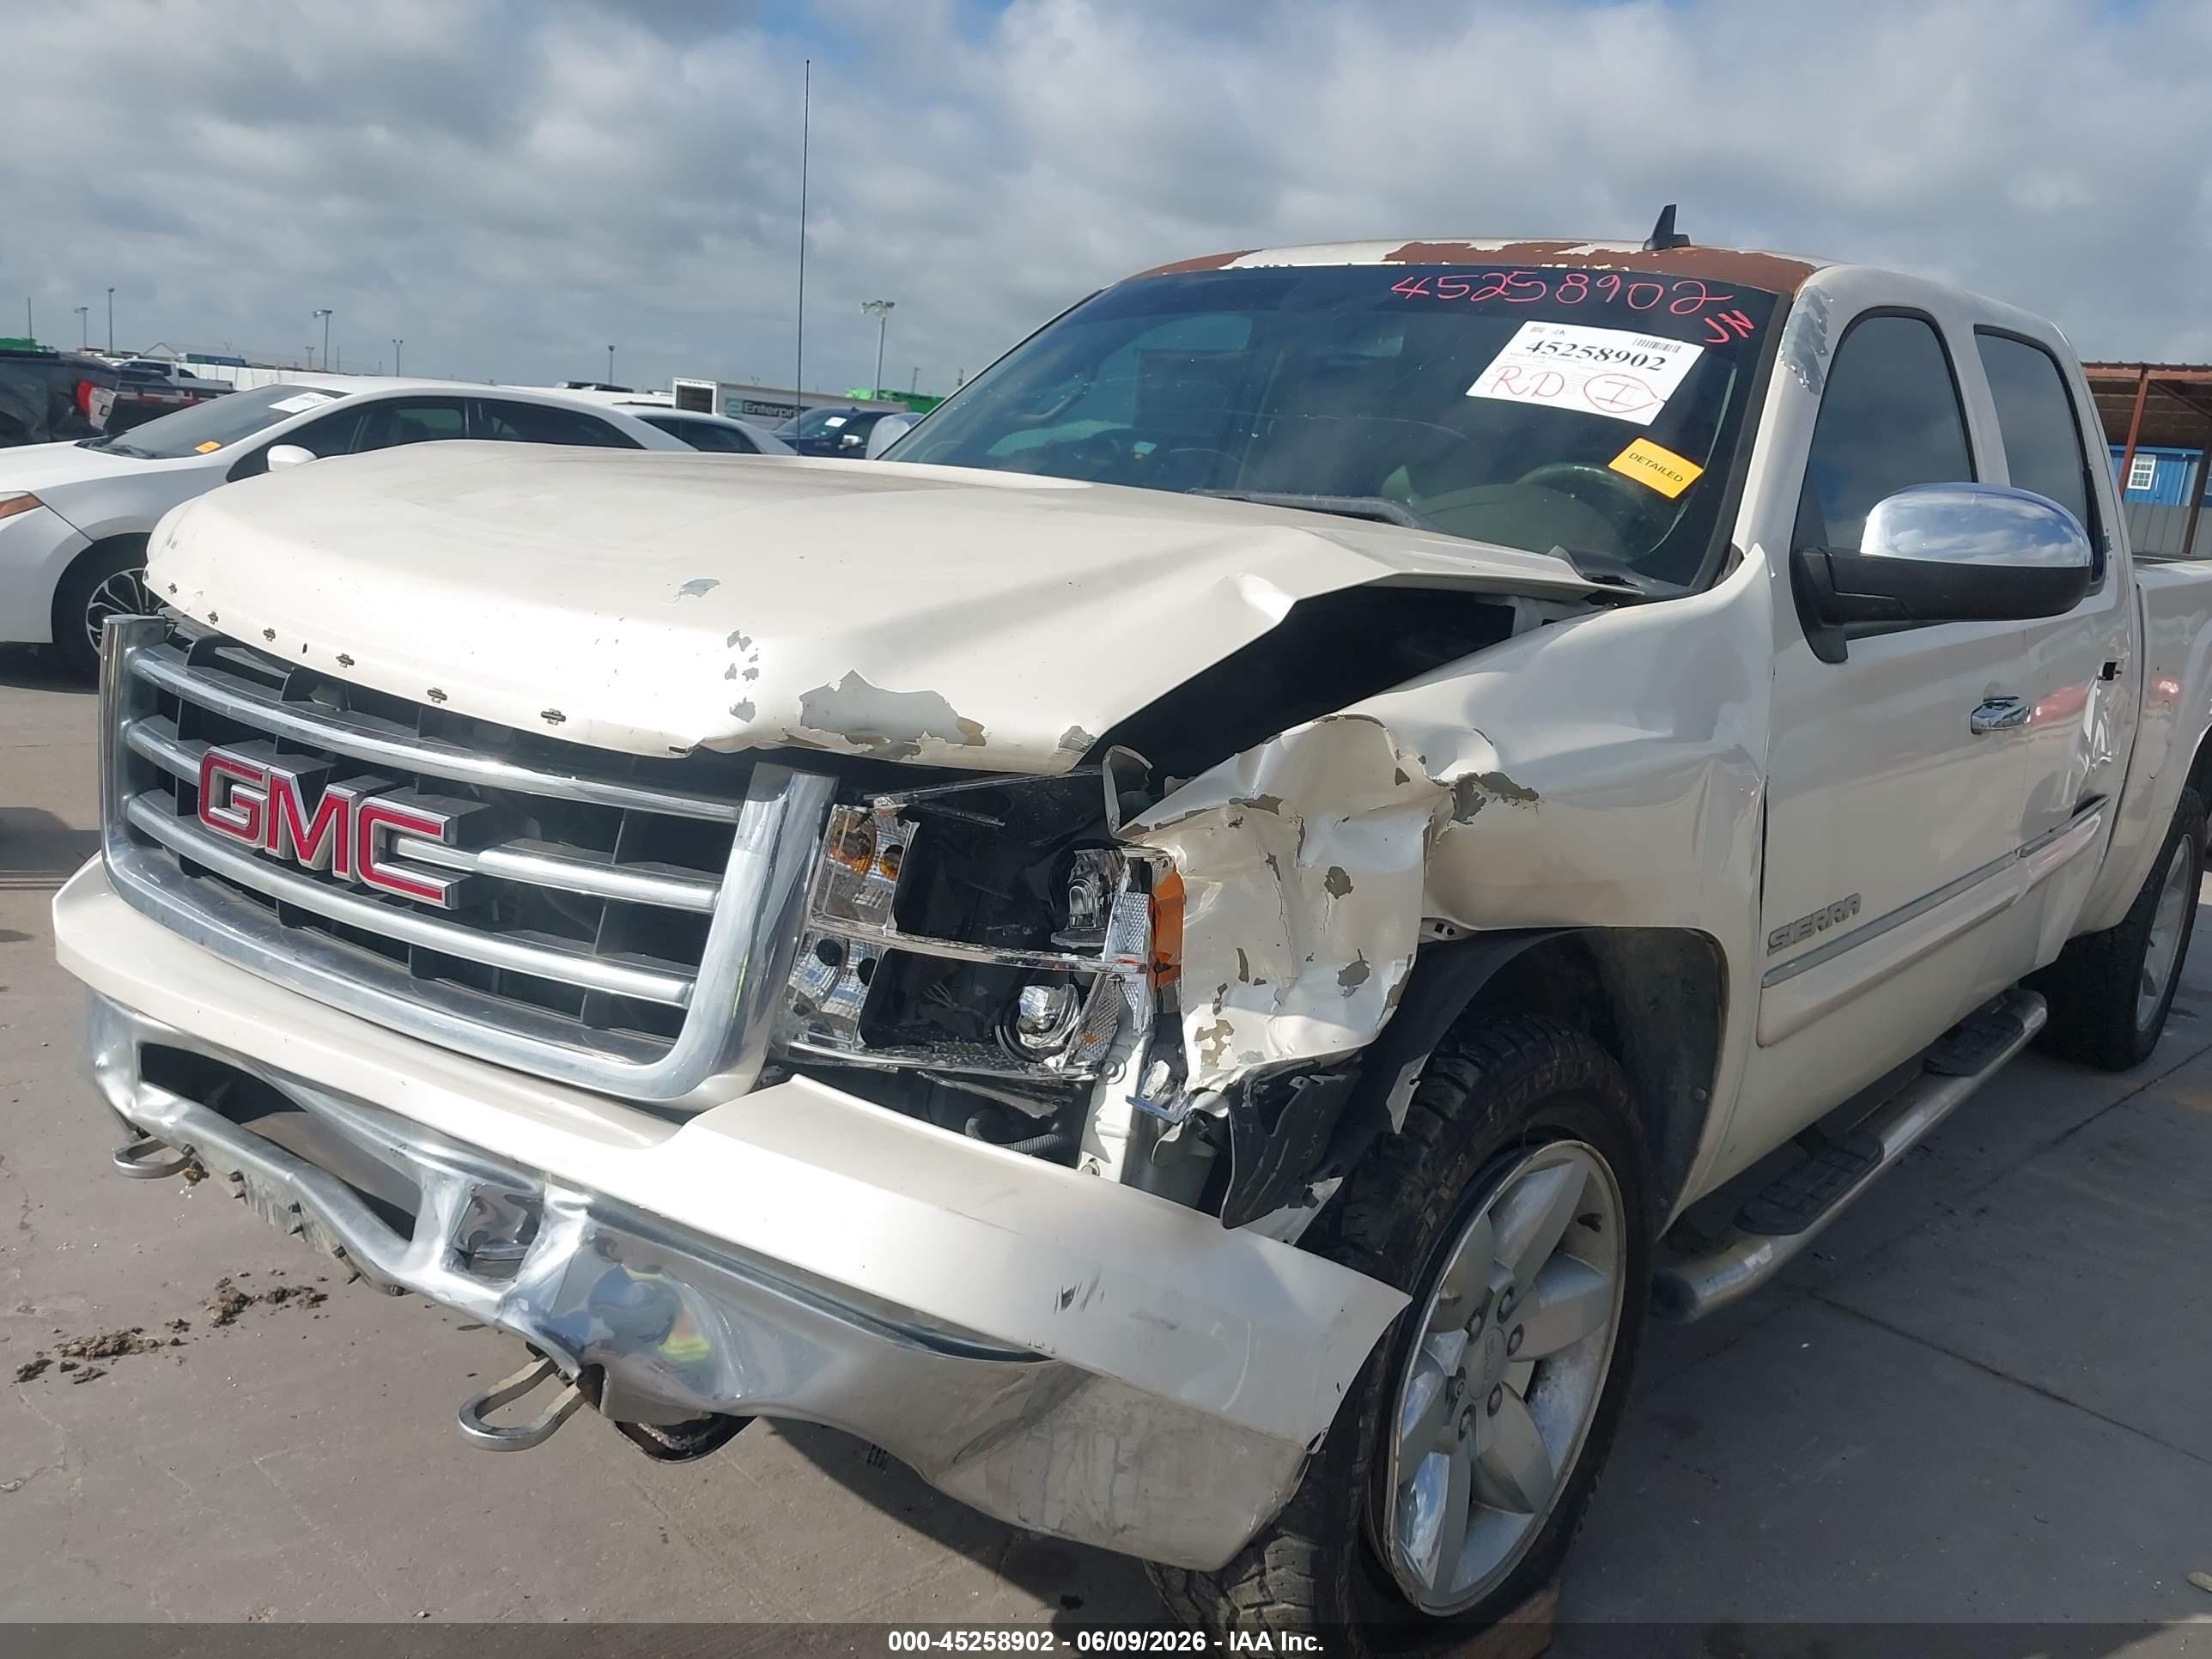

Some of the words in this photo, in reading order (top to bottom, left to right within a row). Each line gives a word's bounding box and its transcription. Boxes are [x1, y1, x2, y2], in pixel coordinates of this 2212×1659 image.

[1390, 270, 1734, 315] 45258902
[1525, 339, 1667, 372] 45258902
[1628, 453, 1684, 483] DETAILED
[198, 745, 458, 909] GMC
[1767, 892, 1862, 957] SIERRA
